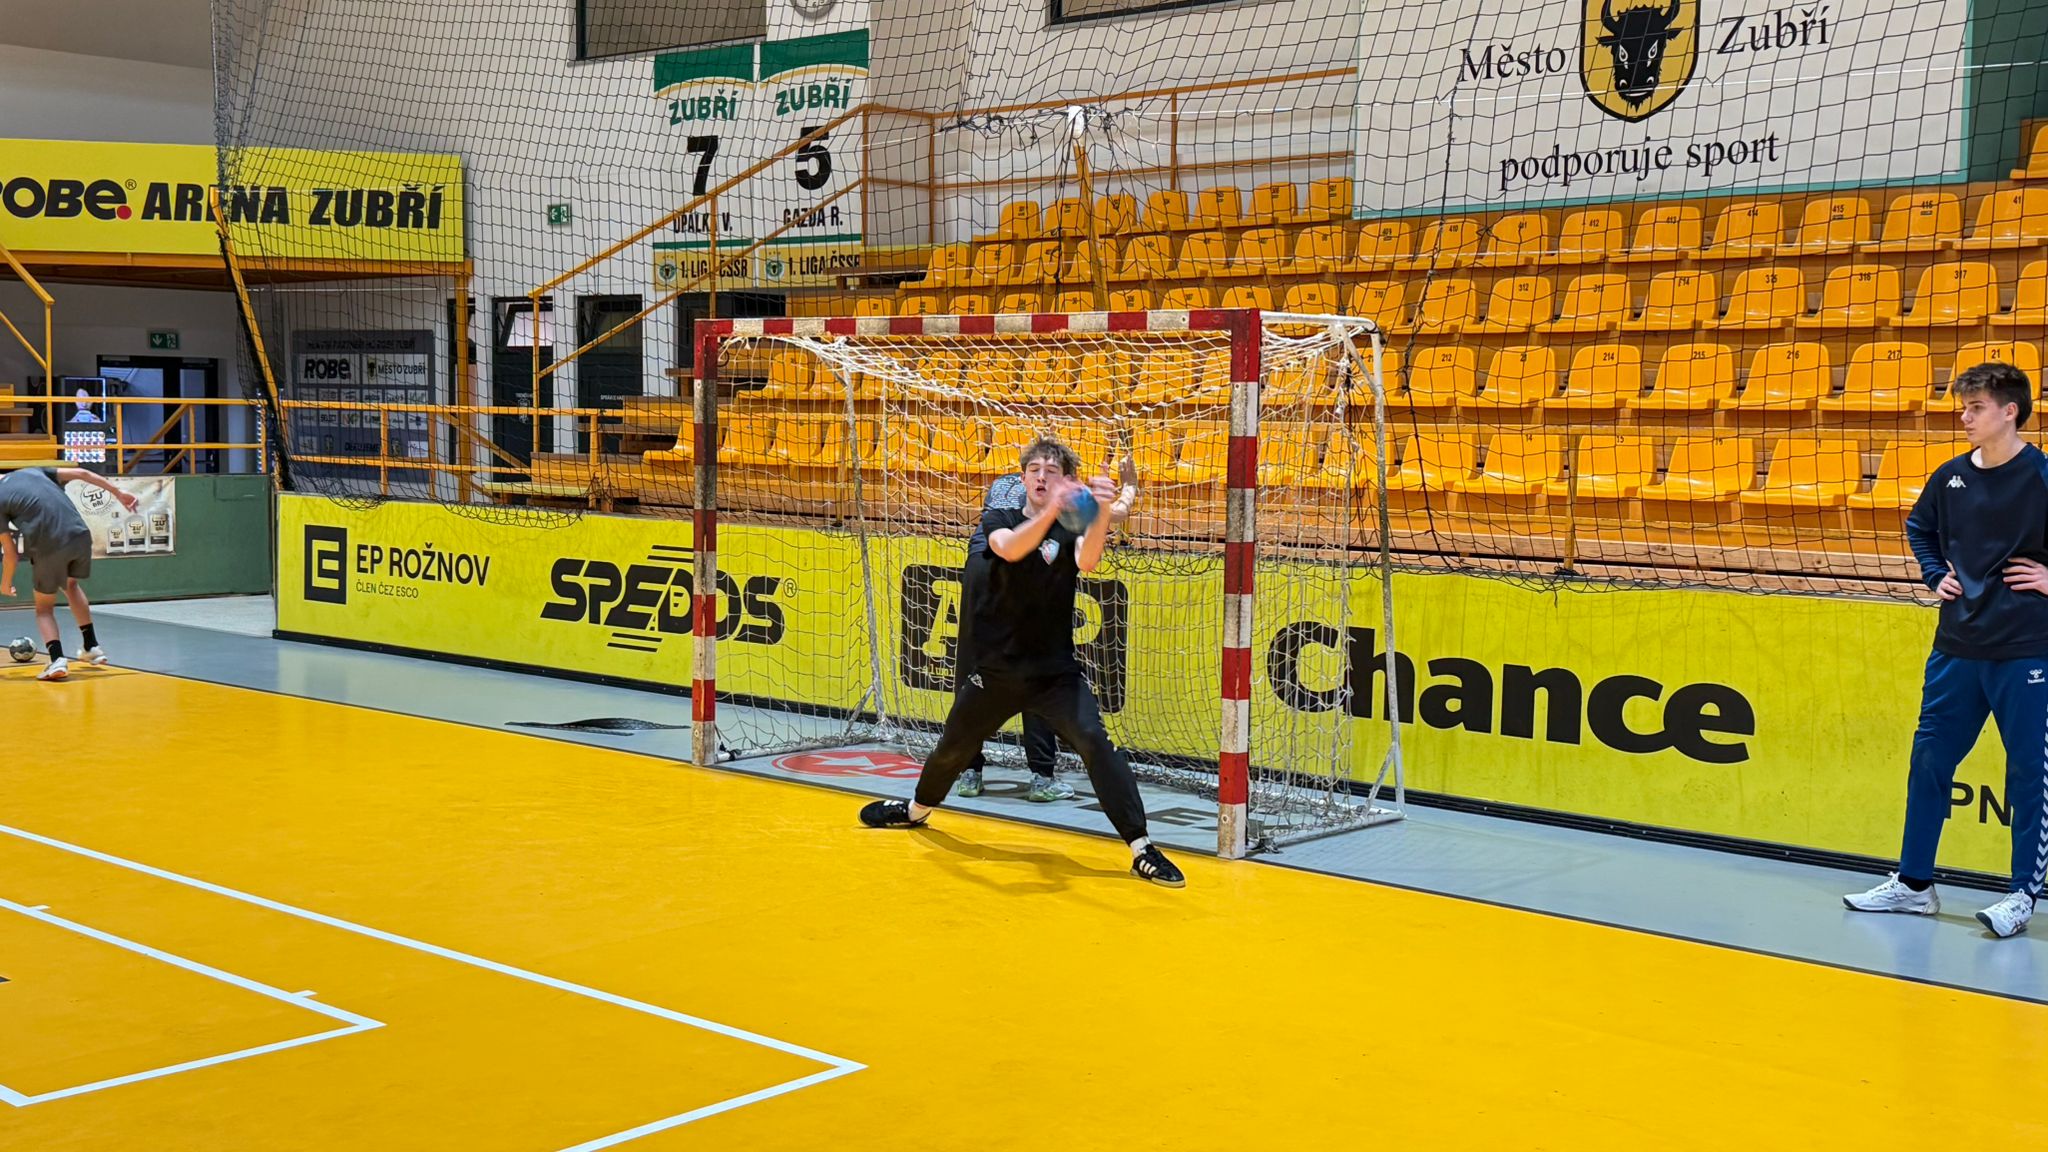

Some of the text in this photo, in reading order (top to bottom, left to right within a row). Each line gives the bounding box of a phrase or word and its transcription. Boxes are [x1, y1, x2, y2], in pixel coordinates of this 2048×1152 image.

[1458, 6, 1831, 82] Město Zubří
[776, 76, 851, 117] ZUBŘÍ
[668, 89, 738, 126] ZUBŘÍ
[687, 135, 719, 196] 7
[795, 126, 832, 191] 5
[1499, 132, 1779, 191] podporuje sport
[308, 183, 443, 229] ZUBŘÍ
[1747, 210, 1758, 218] 414
[1832, 205, 1844, 213] 415
[1922, 200, 1933, 209] 416
[722, 212, 733, 231] V.
[783, 206, 843, 228] GAZDA R.
[1589, 219, 1600, 227] 412
[1666, 216, 1677, 224] 413
[691, 258, 712, 278] LIG
[719, 255, 748, 278] ČSSR
[800, 256, 825, 275] LIGA
[1954, 270, 1967, 279] 317
[1858, 273, 1871, 281] 316
[1518, 283, 1529, 291] 312
[1441, 353, 1452, 361] 212
[1603, 352, 1614, 361] 214
[1693, 351, 1705, 359] 215
[1786, 350, 1799, 359] 216
[1888, 350, 1901, 360] 217
[356, 542, 490, 586] EP ROŽNOV
[356, 579, 419, 599] ČLEN ČEZ ESCO
[540, 558, 785, 645] SPEDOS
[1267, 621, 1756, 764] Chance
